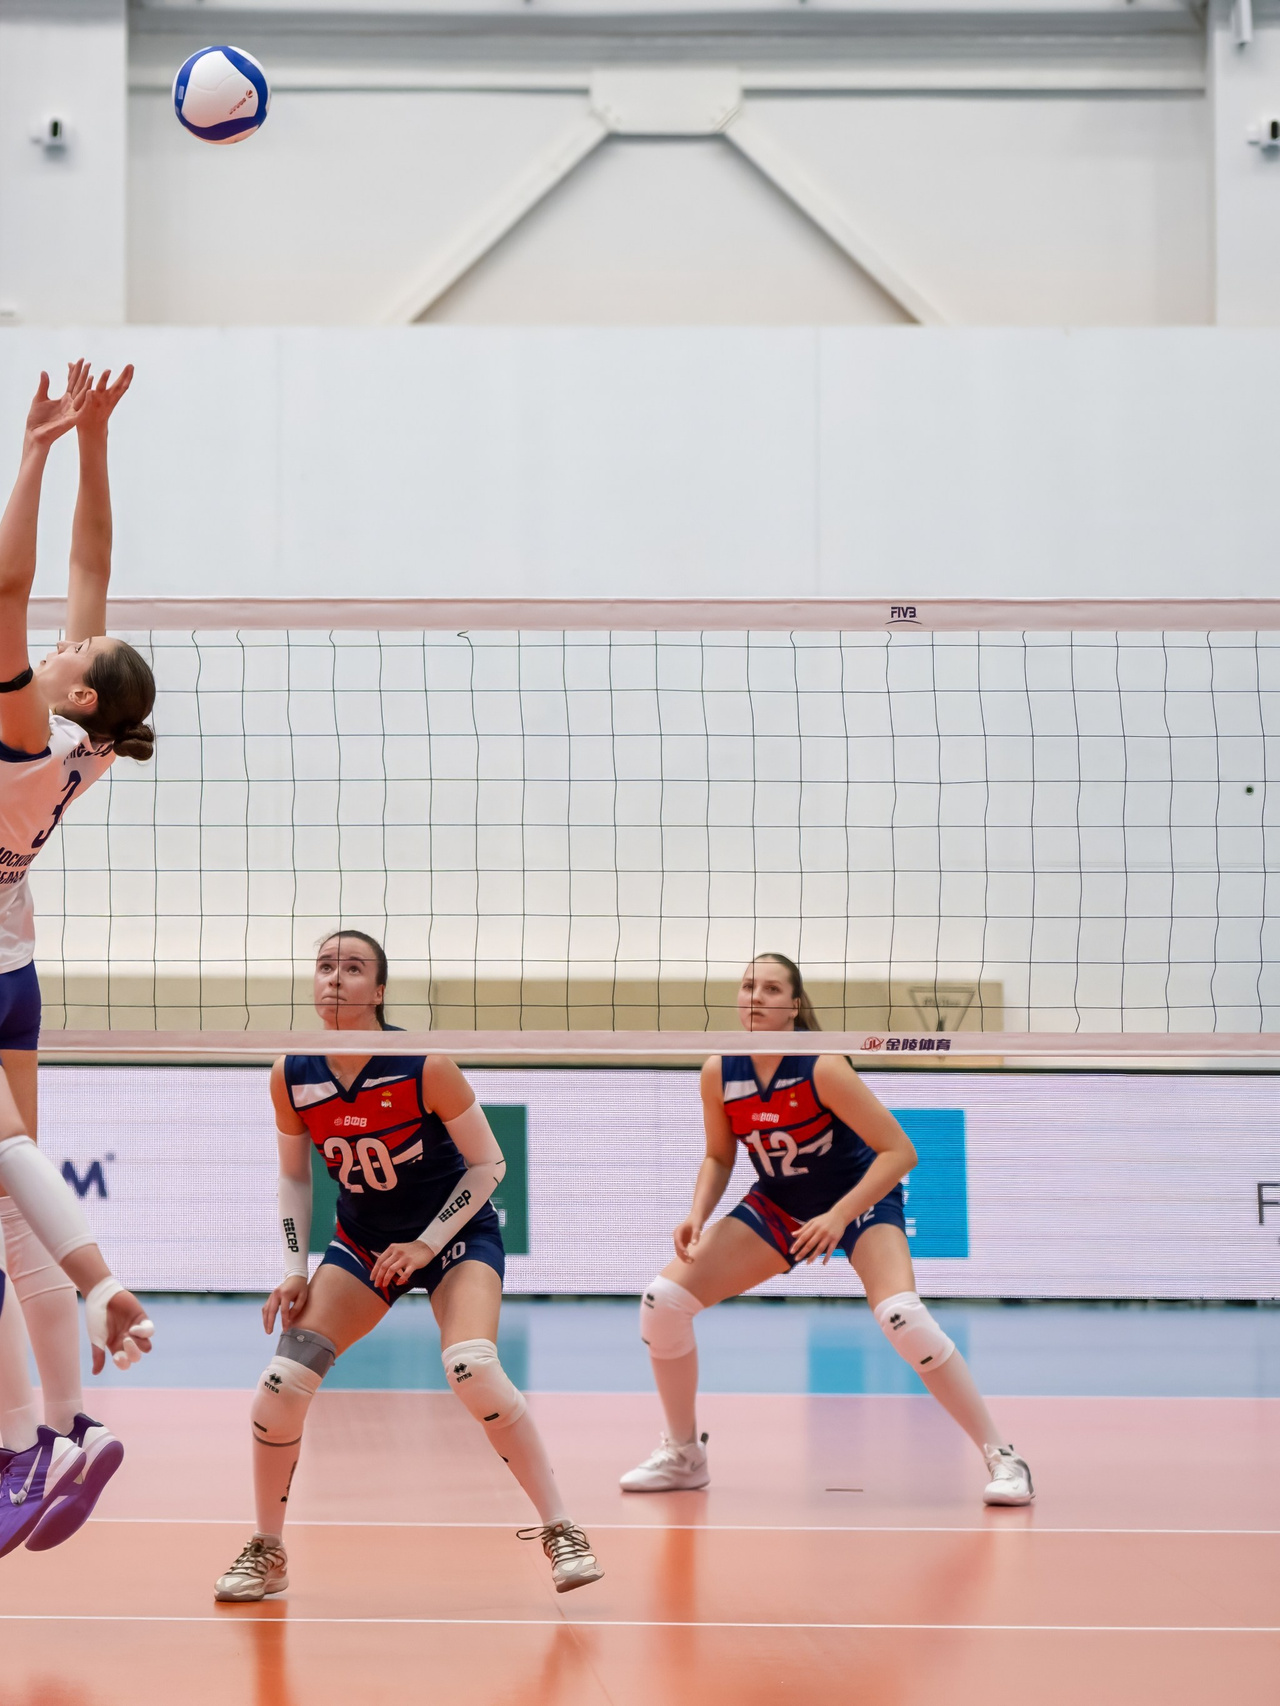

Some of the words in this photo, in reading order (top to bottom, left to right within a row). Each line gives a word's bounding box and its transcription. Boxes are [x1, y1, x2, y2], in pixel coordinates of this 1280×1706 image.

[890, 606, 917, 618] FIVB
[32, 770, 81, 848] 3
[886, 1038, 951, 1051] 金陵体育
[323, 1137, 398, 1193] 20
[745, 1130, 809, 1177] 12
